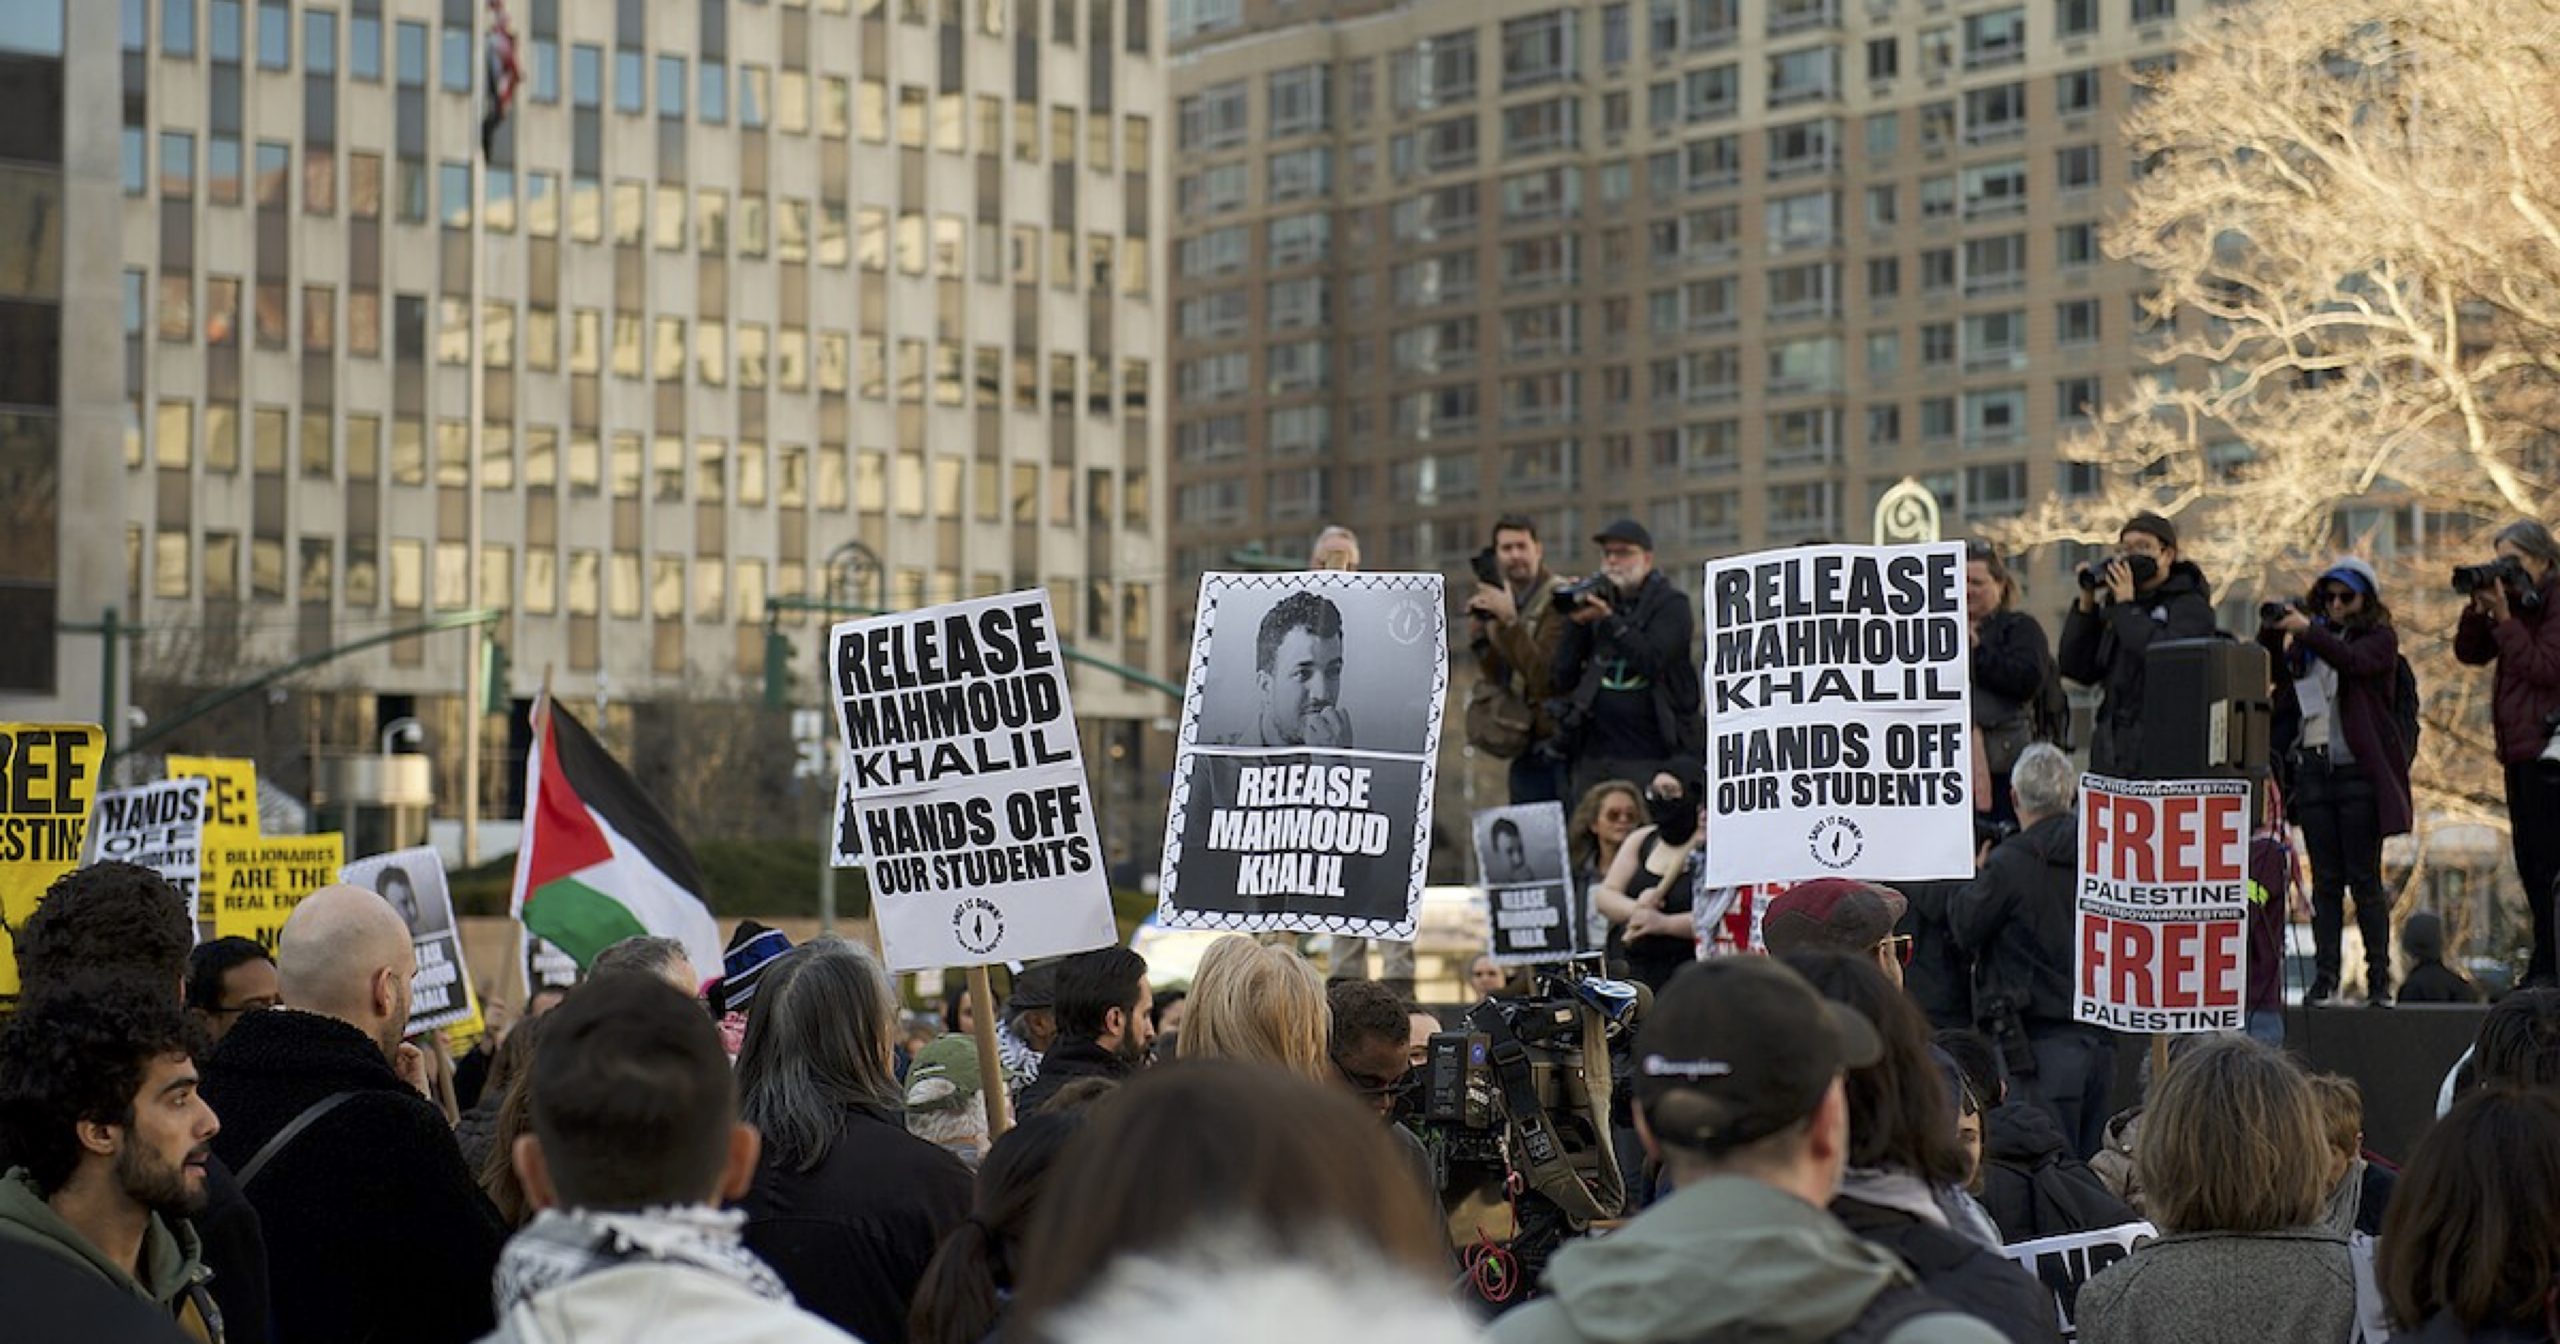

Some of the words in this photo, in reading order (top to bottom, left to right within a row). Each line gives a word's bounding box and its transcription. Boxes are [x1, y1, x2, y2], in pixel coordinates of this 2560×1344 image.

[1715, 554, 1958, 629] RELEASE
[838, 603, 1054, 696] RELEASE
[1715, 617, 1959, 676] MAHMOUD
[844, 672, 1061, 749] MAHMOUD
[1715, 667, 1961, 713] KHALIL
[852, 729, 1072, 788] KHALIL
[1717, 723, 1870, 780] HANDS
[1885, 723, 1962, 769] OFF
[104, 788, 200, 833] HANDS
[1237, 765, 1371, 809] RELEASE
[1717, 775, 1779, 815] OUR
[1792, 771, 1963, 807] STUDENTS
[104, 829, 193, 853] OFF
[866, 799, 996, 857] HANDS
[1006, 785, 1082, 846] OFF
[1207, 809, 1389, 857] MAHMOUD
[2086, 790, 2241, 882] FREE
[226, 849, 334, 864] BILLIONAIRES
[231, 868, 278, 889] ARE
[288, 868, 332, 889] THE
[876, 856, 931, 896] OUR
[936, 836, 1092, 891] STUDENTS
[1237, 853, 1344, 897] KHALIL
[224, 895, 266, 911] REAL
[2084, 878, 2242, 905] PALESTINE
[2083, 914, 2239, 1008] FREE
[2081, 1002, 2239, 1030] PALESTINE
